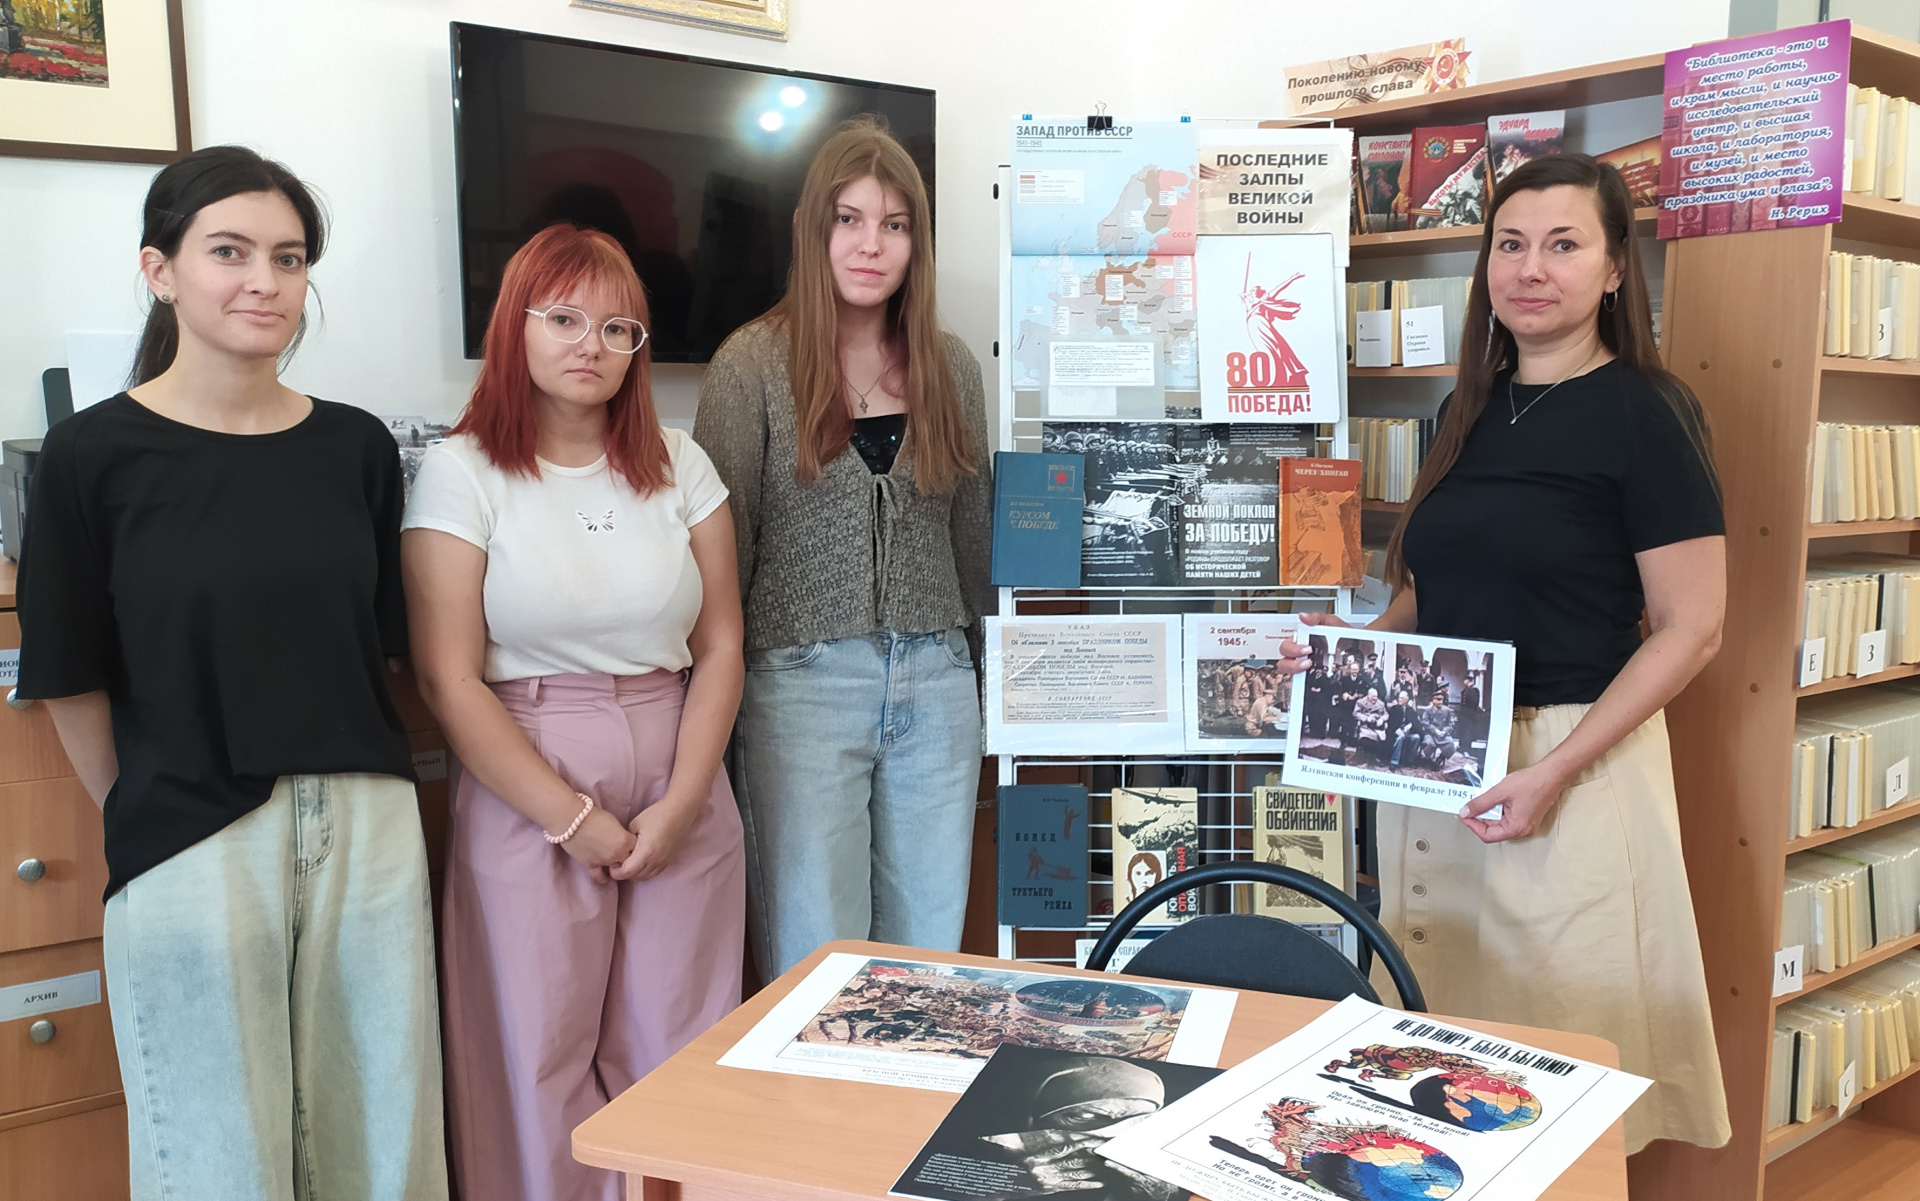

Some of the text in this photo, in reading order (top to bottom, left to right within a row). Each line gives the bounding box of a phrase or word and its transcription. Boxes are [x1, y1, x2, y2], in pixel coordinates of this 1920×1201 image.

[1786, 41, 1813, 52] это
[1818, 38, 1826, 47] и
[1288, 61, 1422, 89] Поколению новому
[1701, 60, 1806, 84] место работы,
[1301, 80, 1413, 106] прошлого слава
[1672, 73, 1839, 108] и храм мысли, и научно-
[1687, 90, 1820, 120] исследовательский
[1016, 126, 1133, 138] ЗАПАД ПРОТИВ СССР
[1693, 112, 1811, 138] центр, и высшая
[1672, 126, 1832, 156] школа, и лаборатория,
[1217, 153, 1328, 168] ПОСЛЕДНИЕ
[1692, 147, 1807, 171] и музей, и место
[1239, 173, 1304, 185] ЗАЛПЫ
[1428, 150, 1487, 207] ВЫСОТЫ МУЖЕСТВА
[1683, 165, 1813, 188] высоких радостей,
[1228, 190, 1313, 205] ВЕЛИКОЙ
[1665, 189, 1736, 208] праздника
[1739, 188, 1766, 201] ума
[1770, 187, 1779, 195] и
[1237, 208, 1304, 224] ВОЙНЫ
[1770, 205, 1828, 219] Н. Рерих
[1226, 351, 1271, 387] 80
[1227, 394, 1311, 415] ПОБЕДА!
[1009, 510, 1051, 520] КУРСОМ
[1183, 503, 1275, 519] ЗЕМНОЙ ПОКЛОН
[1017, 520, 1059, 530] ПОБЕДЕ
[1185, 523, 1275, 545] ЗА ПОБЕДУ!
[1240, 570, 1261, 578] ДЕТЕЙ
[1217, 627, 1256, 635] сентября
[1218, 638, 1241, 646] 1945
[1300, 764, 1344, 779] Ялтинская
[1345, 774, 1400, 788] конференция
[1409, 782, 1445, 796] феврале
[1448, 789, 1468, 799] 1945
[1266, 792, 1325, 811] СВИДЕТЕЛИ
[1266, 811, 1337, 831] ОБВИНЕНИЯ
[1015, 833, 1056, 842] КОНЕЦ
[1012, 888, 1054, 897] ТРЕТЬЕГО
[1044, 900, 1072, 910] РЕЙХА
[24, 991, 58, 1004] АРХИВ
[1393, 1019, 1579, 1077] НЕ ДО ЖИРУ, БЫТЬ БЫ ЖИВУ
[1453, 1073, 1515, 1091] СССР
[1326, 1094, 1342, 1102] Мы
[1346, 1100, 1385, 1116] завоюем
[1389, 1115, 1408, 1123] шар
[1332, 1091, 1353, 1101] Орал
[1443, 1126, 1471, 1137] мной!
[1213, 1163, 1225, 1171] Но
[1244, 1176, 1276, 1193] грозит,
[1220, 1159, 1250, 1175] Теперь
[1254, 1174, 1278, 1185] орет
